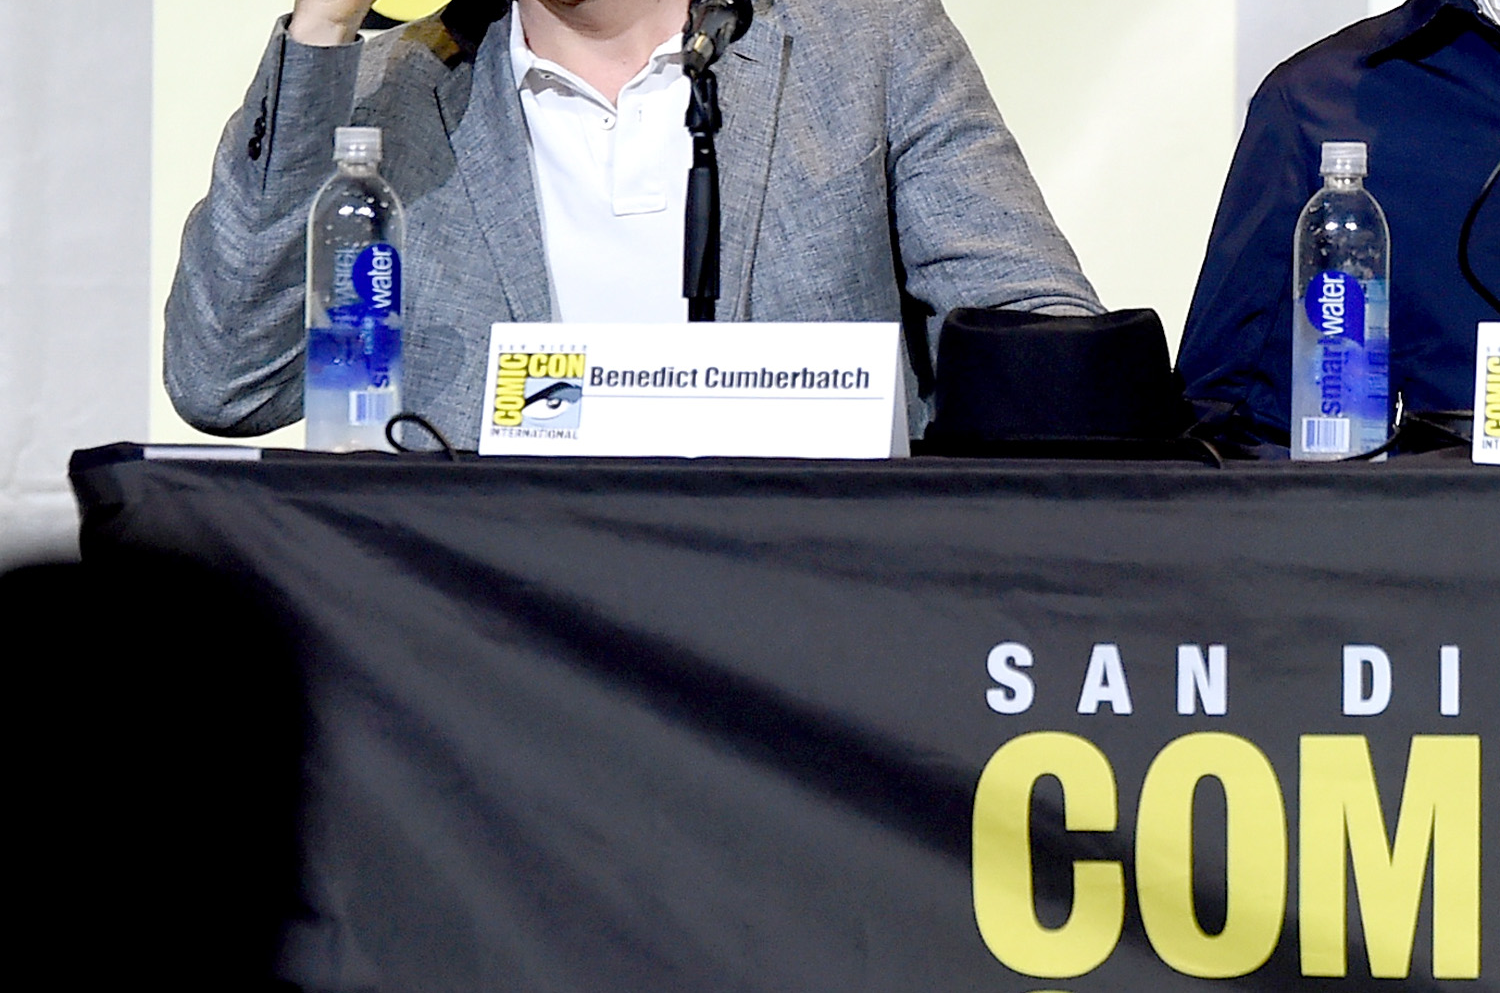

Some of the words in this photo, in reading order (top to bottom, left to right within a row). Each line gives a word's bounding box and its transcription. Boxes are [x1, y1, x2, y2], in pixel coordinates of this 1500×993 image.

[493, 354, 529, 427] COMIC
[528, 353, 586, 379] CON
[589, 366, 698, 389] Benedict
[704, 366, 870, 390] Cumberbatch
[985, 643, 1229, 715] SAN
